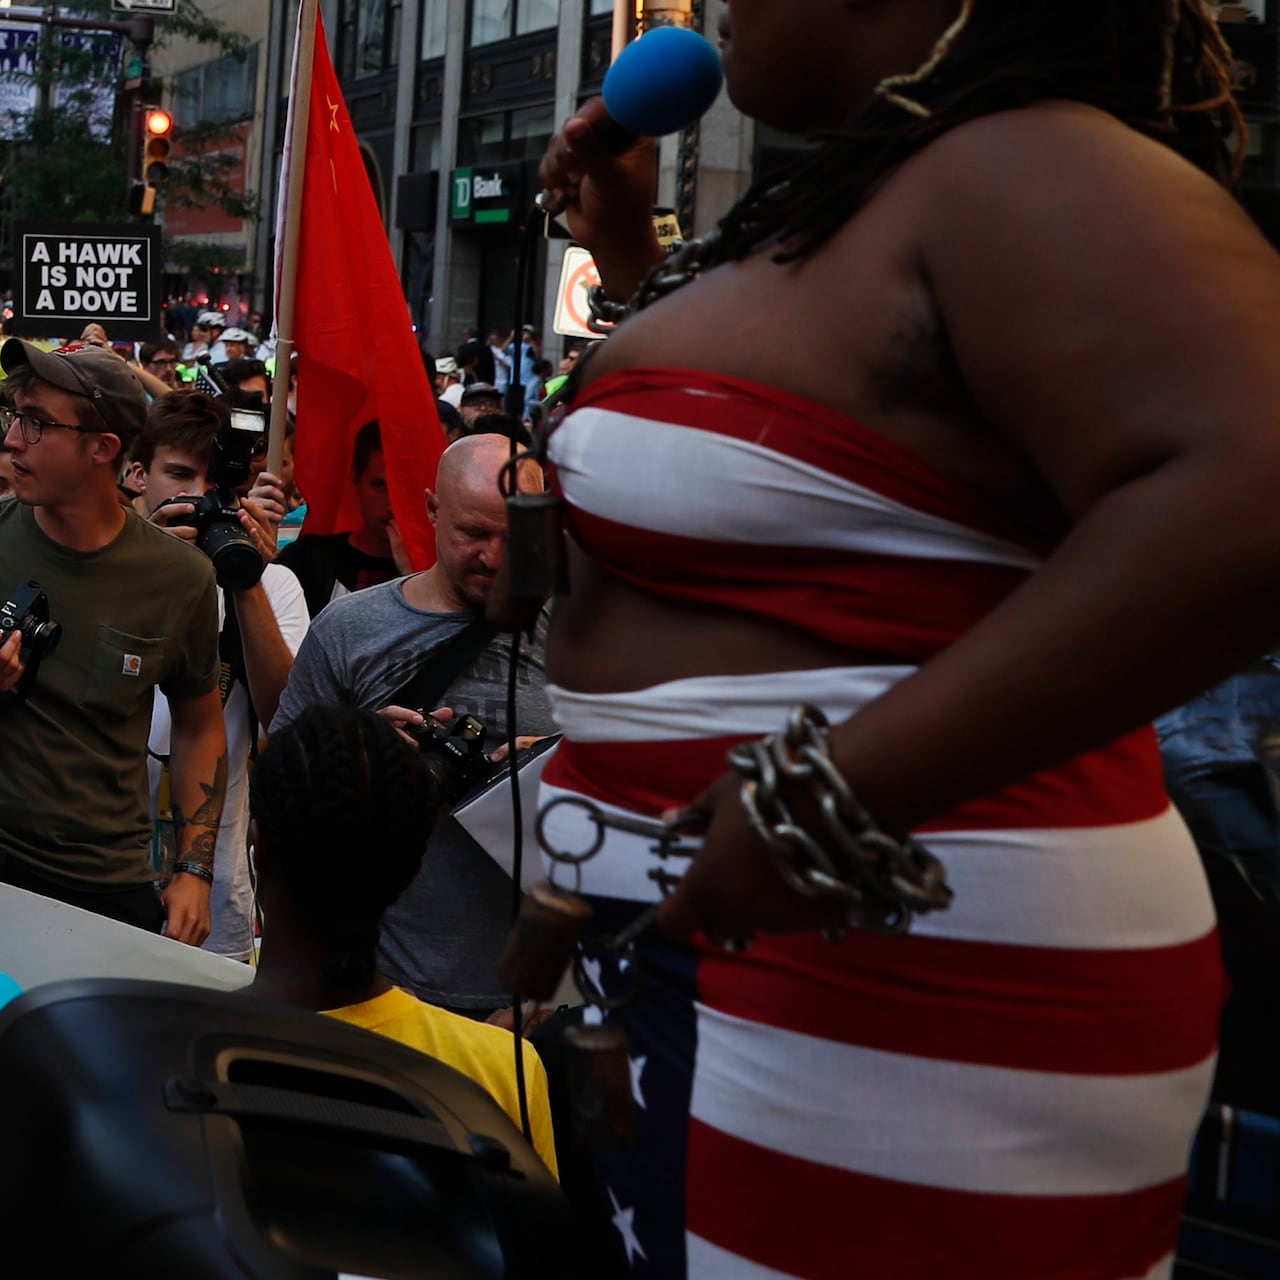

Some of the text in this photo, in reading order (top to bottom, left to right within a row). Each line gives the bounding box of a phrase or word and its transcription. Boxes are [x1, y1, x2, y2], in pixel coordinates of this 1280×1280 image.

[455, 173, 502, 207] TD Bank
[31, 242, 142, 265] A HAWK
[41, 265, 133, 288] IS NOT
[35, 289, 137, 312] A DOVE
